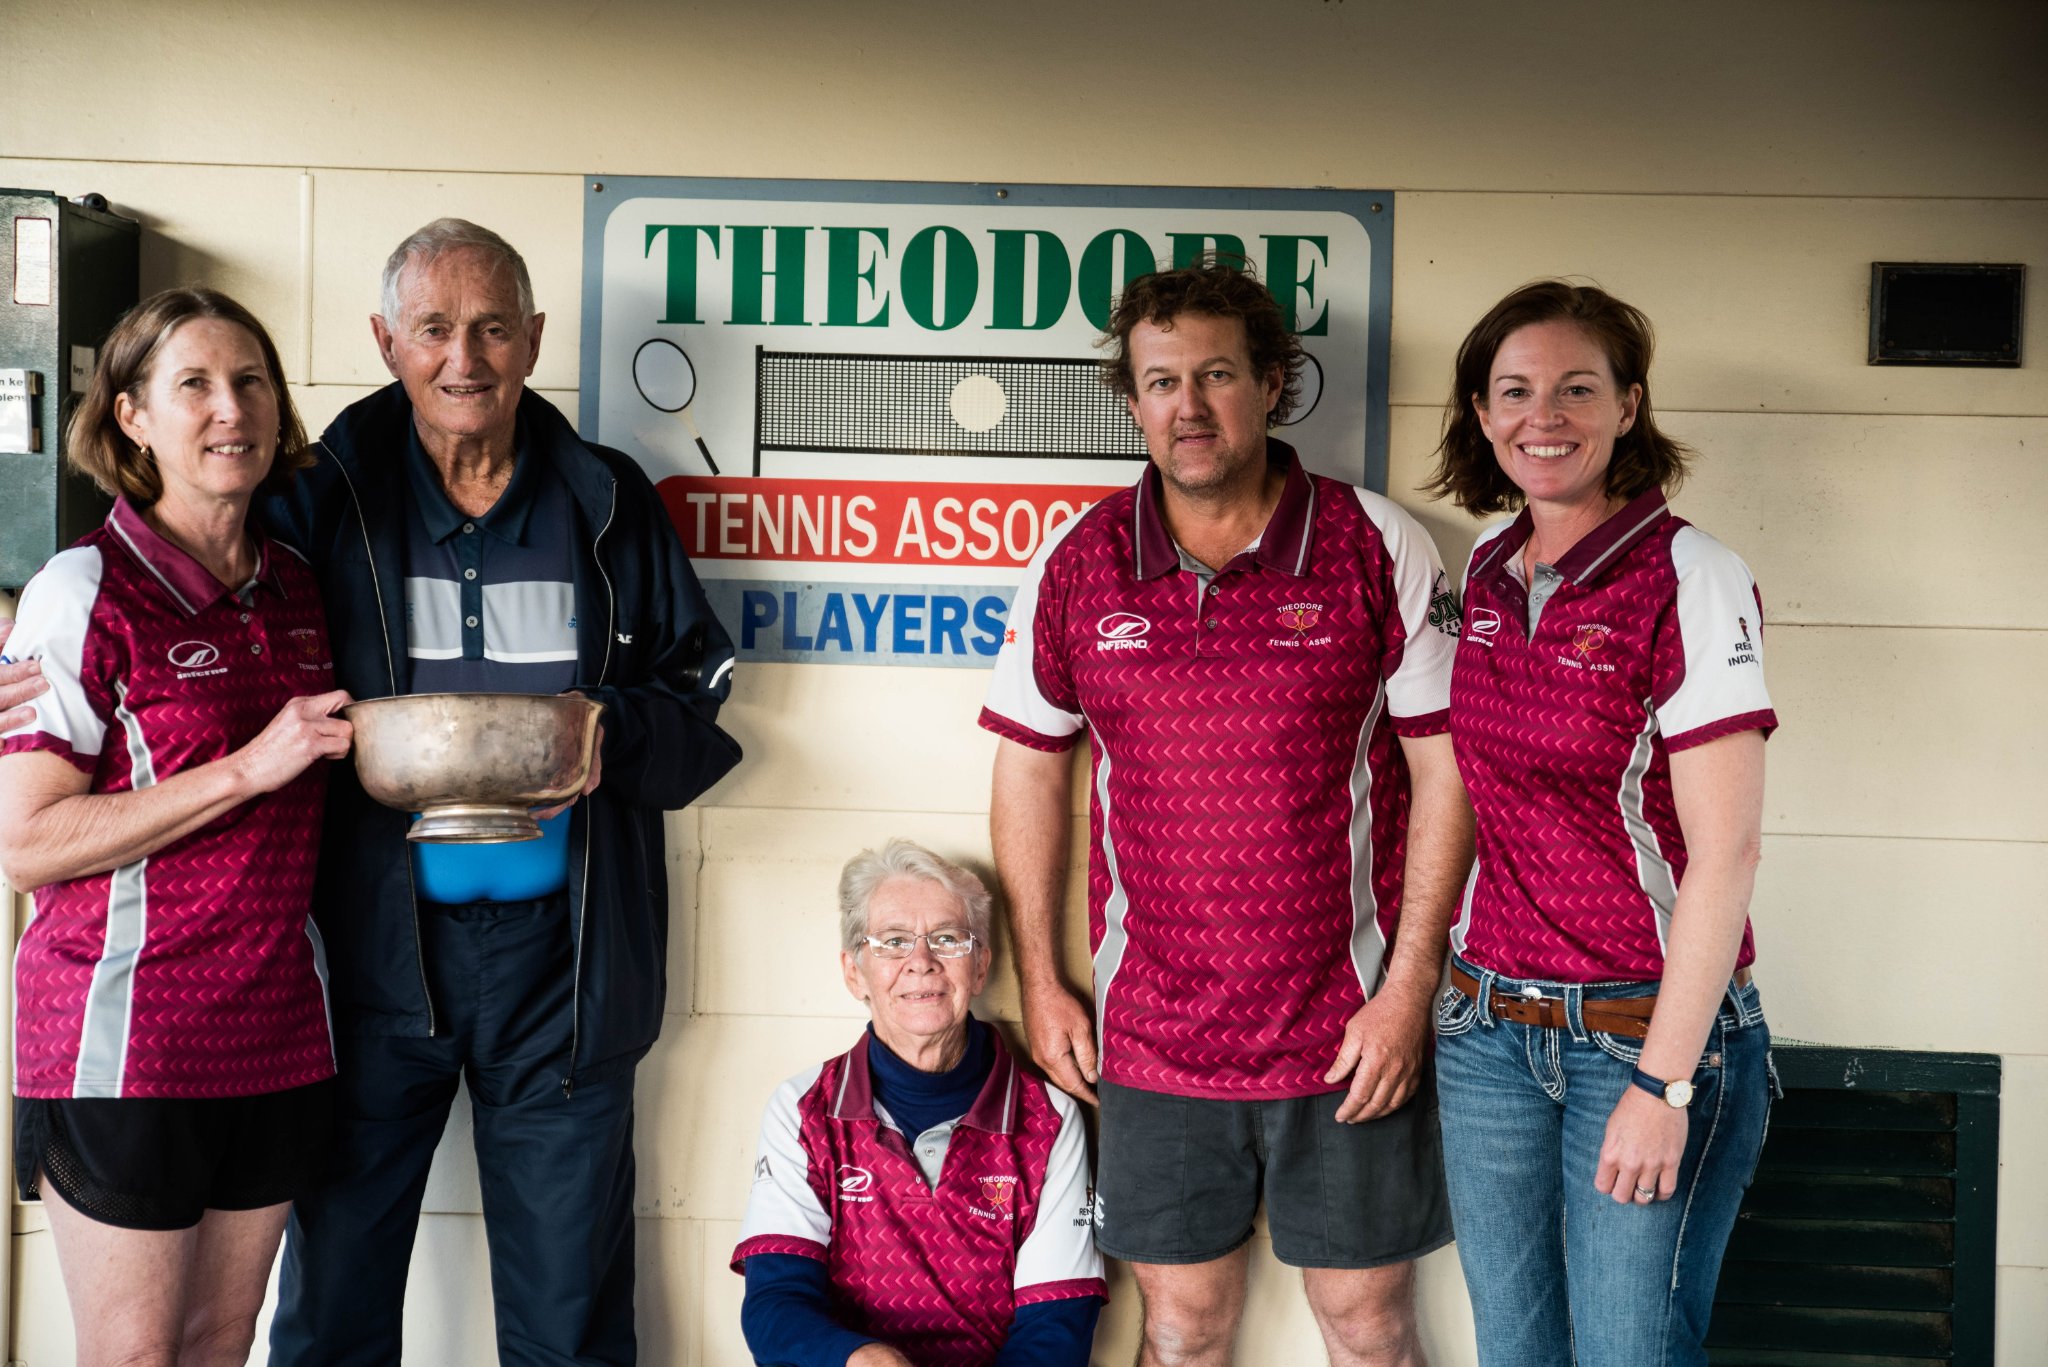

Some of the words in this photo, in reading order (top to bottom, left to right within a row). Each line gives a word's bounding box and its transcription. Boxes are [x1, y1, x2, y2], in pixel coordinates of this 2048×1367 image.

[686, 492, 878, 558] TENNIS
[1277, 602, 1323, 613] THEODORE
[741, 589, 1009, 657] PLAYERS
[1576, 623, 1612, 636] THEODORE
[1097, 639, 1148, 652] INFERNO
[1269, 638, 1300, 648] TENNIS
[1308, 636, 1332, 647] ASSN
[1557, 655, 1583, 670] TENNIS
[1590, 663, 1615, 672] ASSN
[977, 1175, 1018, 1185] THEODORE
[968, 1205, 996, 1220] TENNIS
